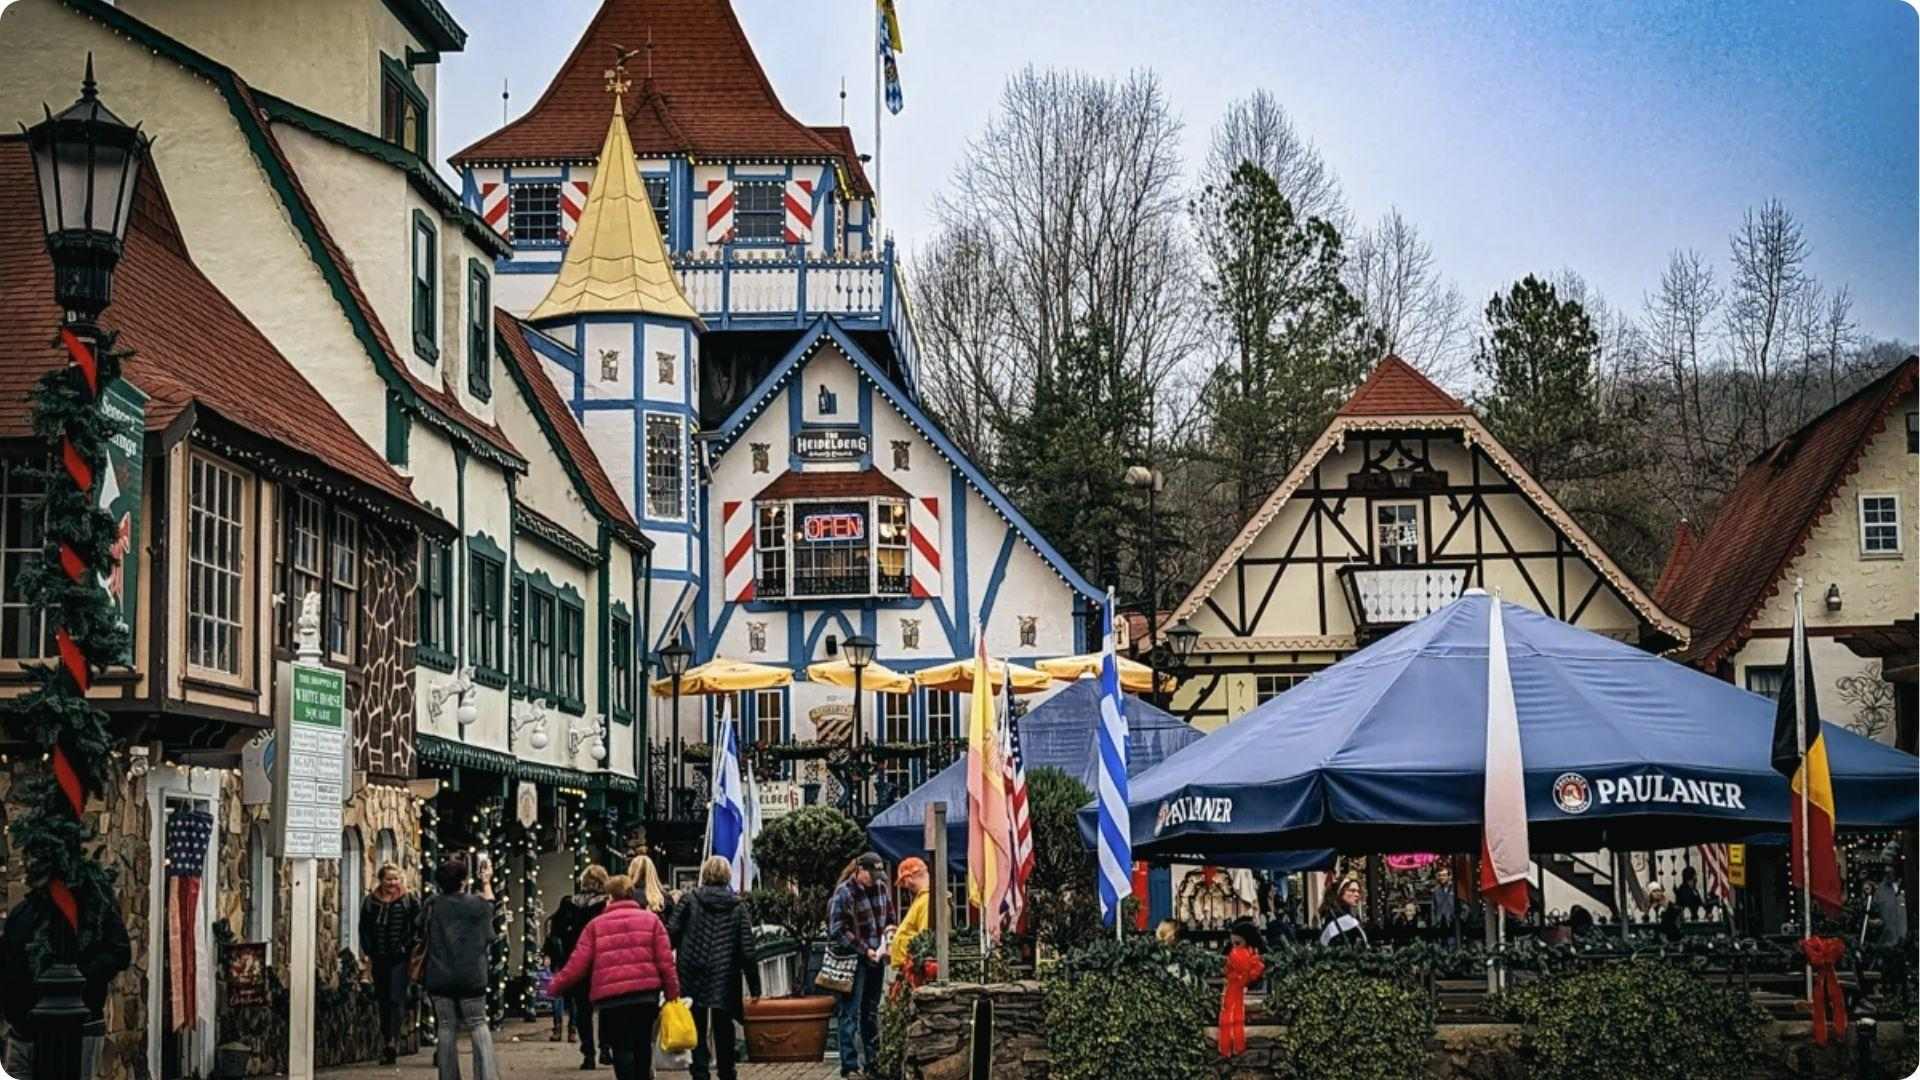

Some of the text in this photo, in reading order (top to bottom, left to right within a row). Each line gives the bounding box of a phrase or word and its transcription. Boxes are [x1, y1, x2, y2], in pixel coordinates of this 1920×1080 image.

[797, 437, 867, 453] HEIDELBERG
[807, 516, 861, 538] OPEN
[295, 688, 342, 707] WHITE HORSE
[305, 706, 331, 721] SQUARE
[1595, 775, 1746, 809] PAULANER
